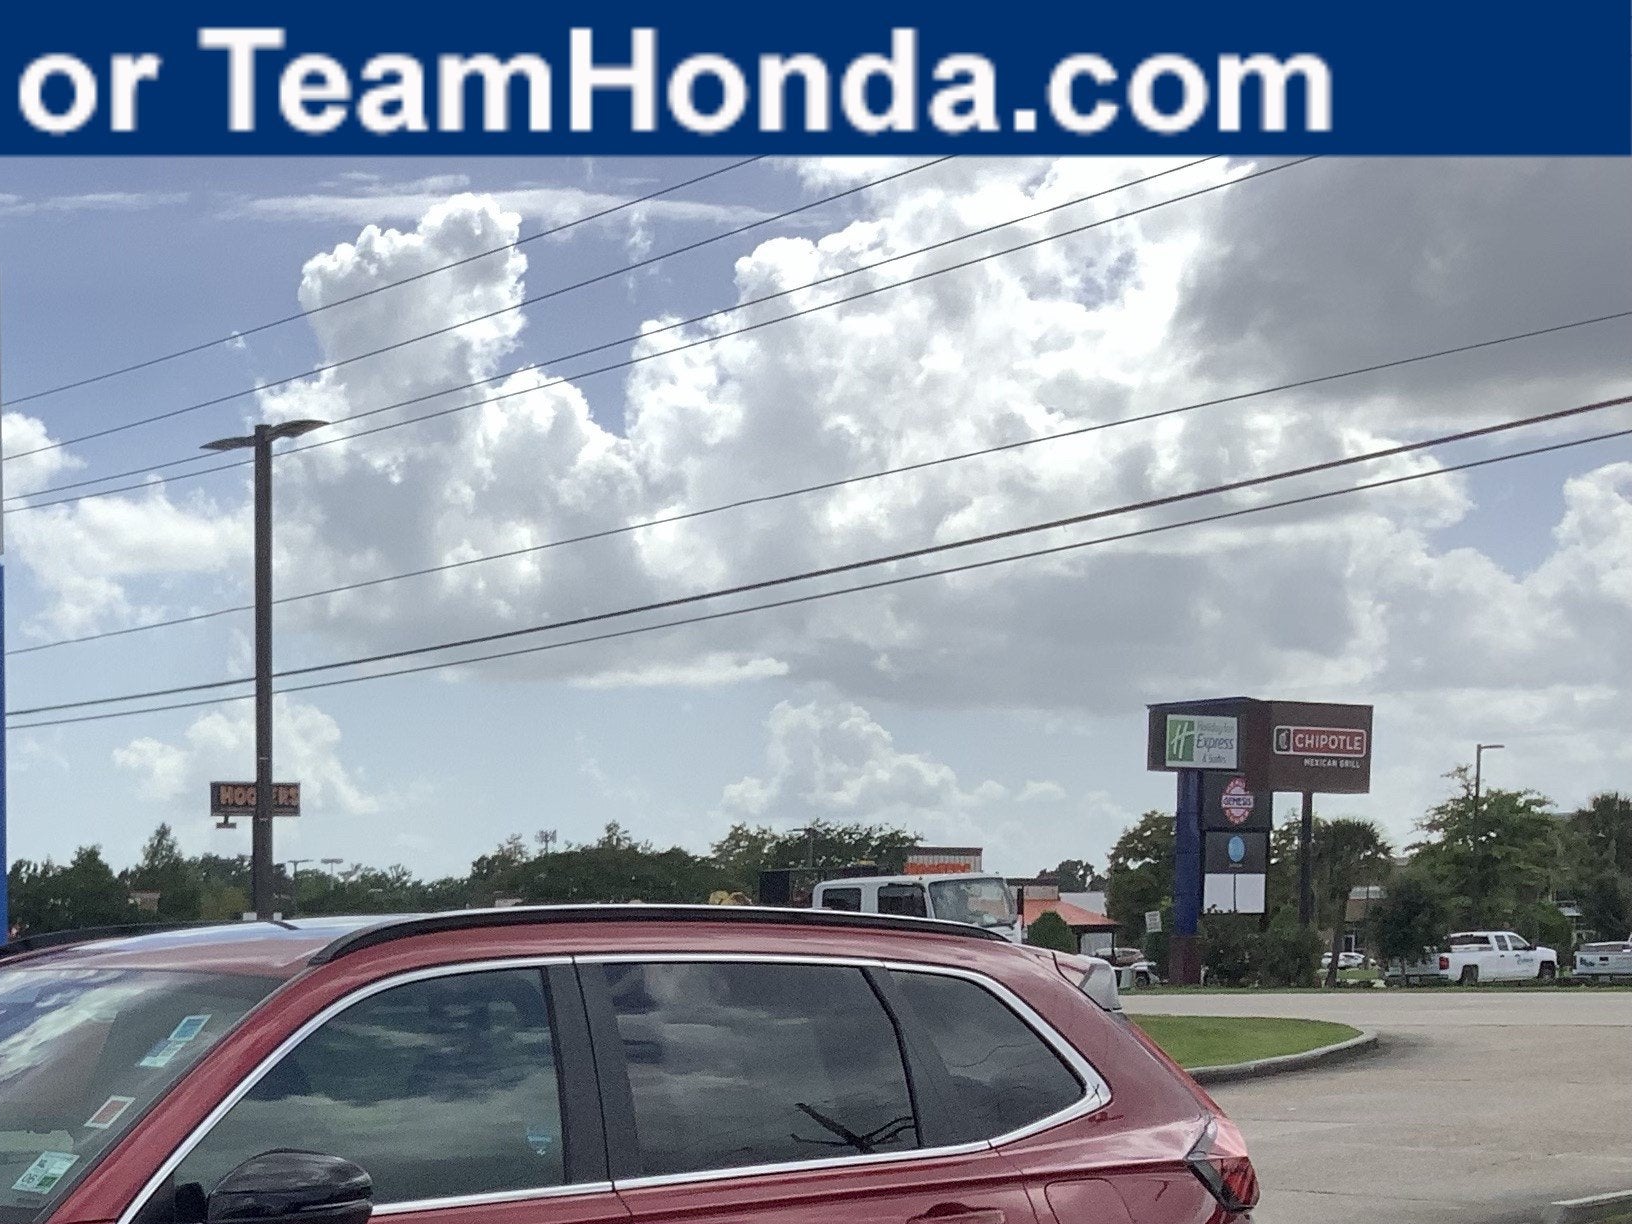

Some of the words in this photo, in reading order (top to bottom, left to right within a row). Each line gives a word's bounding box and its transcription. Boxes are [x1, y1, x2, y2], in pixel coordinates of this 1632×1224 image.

[1197, 733, 1234, 752] Express
[1295, 733, 1362, 751] CHIPOTLE
[1303, 758, 1338, 767] MEXICAN
[1339, 759, 1361, 769] GRILL
